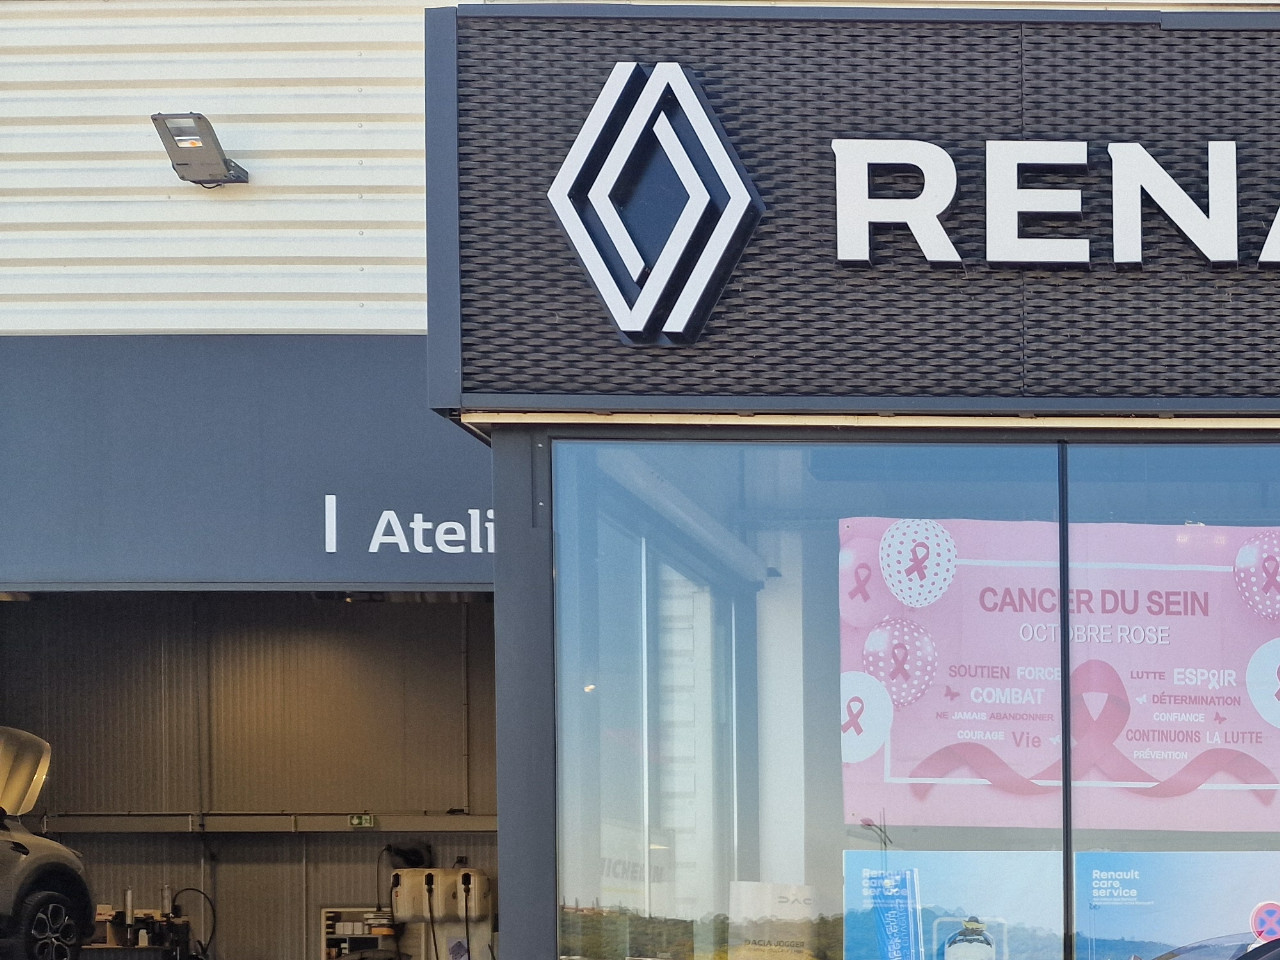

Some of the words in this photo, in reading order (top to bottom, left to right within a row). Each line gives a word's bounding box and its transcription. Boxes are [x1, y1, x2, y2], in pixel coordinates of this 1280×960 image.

[368, 508, 495, 554] Ateli
[1100, 589, 1140, 615] DU
[1146, 591, 1210, 617] SEIN
[1117, 625, 1171, 645] ROSE
[948, 665, 1010, 680] SOUTIEN
[1016, 666, 1061, 681] FORCE
[1130, 671, 1166, 681] LUTTE
[970, 687, 1046, 705] COMBAT
[1152, 691, 1241, 706] DÉTERMINATION
[935, 711, 949, 720] NE
[952, 711, 987, 721] JAMAIS
[989, 712, 1055, 721] ABANDONNER
[1153, 712, 1206, 722] CONFIANCE
[957, 730, 1005, 740] COURAGE
[1012, 731, 1042, 748] Vie
[1125, 728, 1202, 743] CONTINUONS
[1206, 731, 1221, 744] LA
[1224, 731, 1263, 744] LUTTE
[1133, 749, 1188, 760] PRÉVENTION
[1092, 869, 1140, 879] Renault
[1092, 880, 1121, 888] care
[1092, 887, 1138, 897] service
